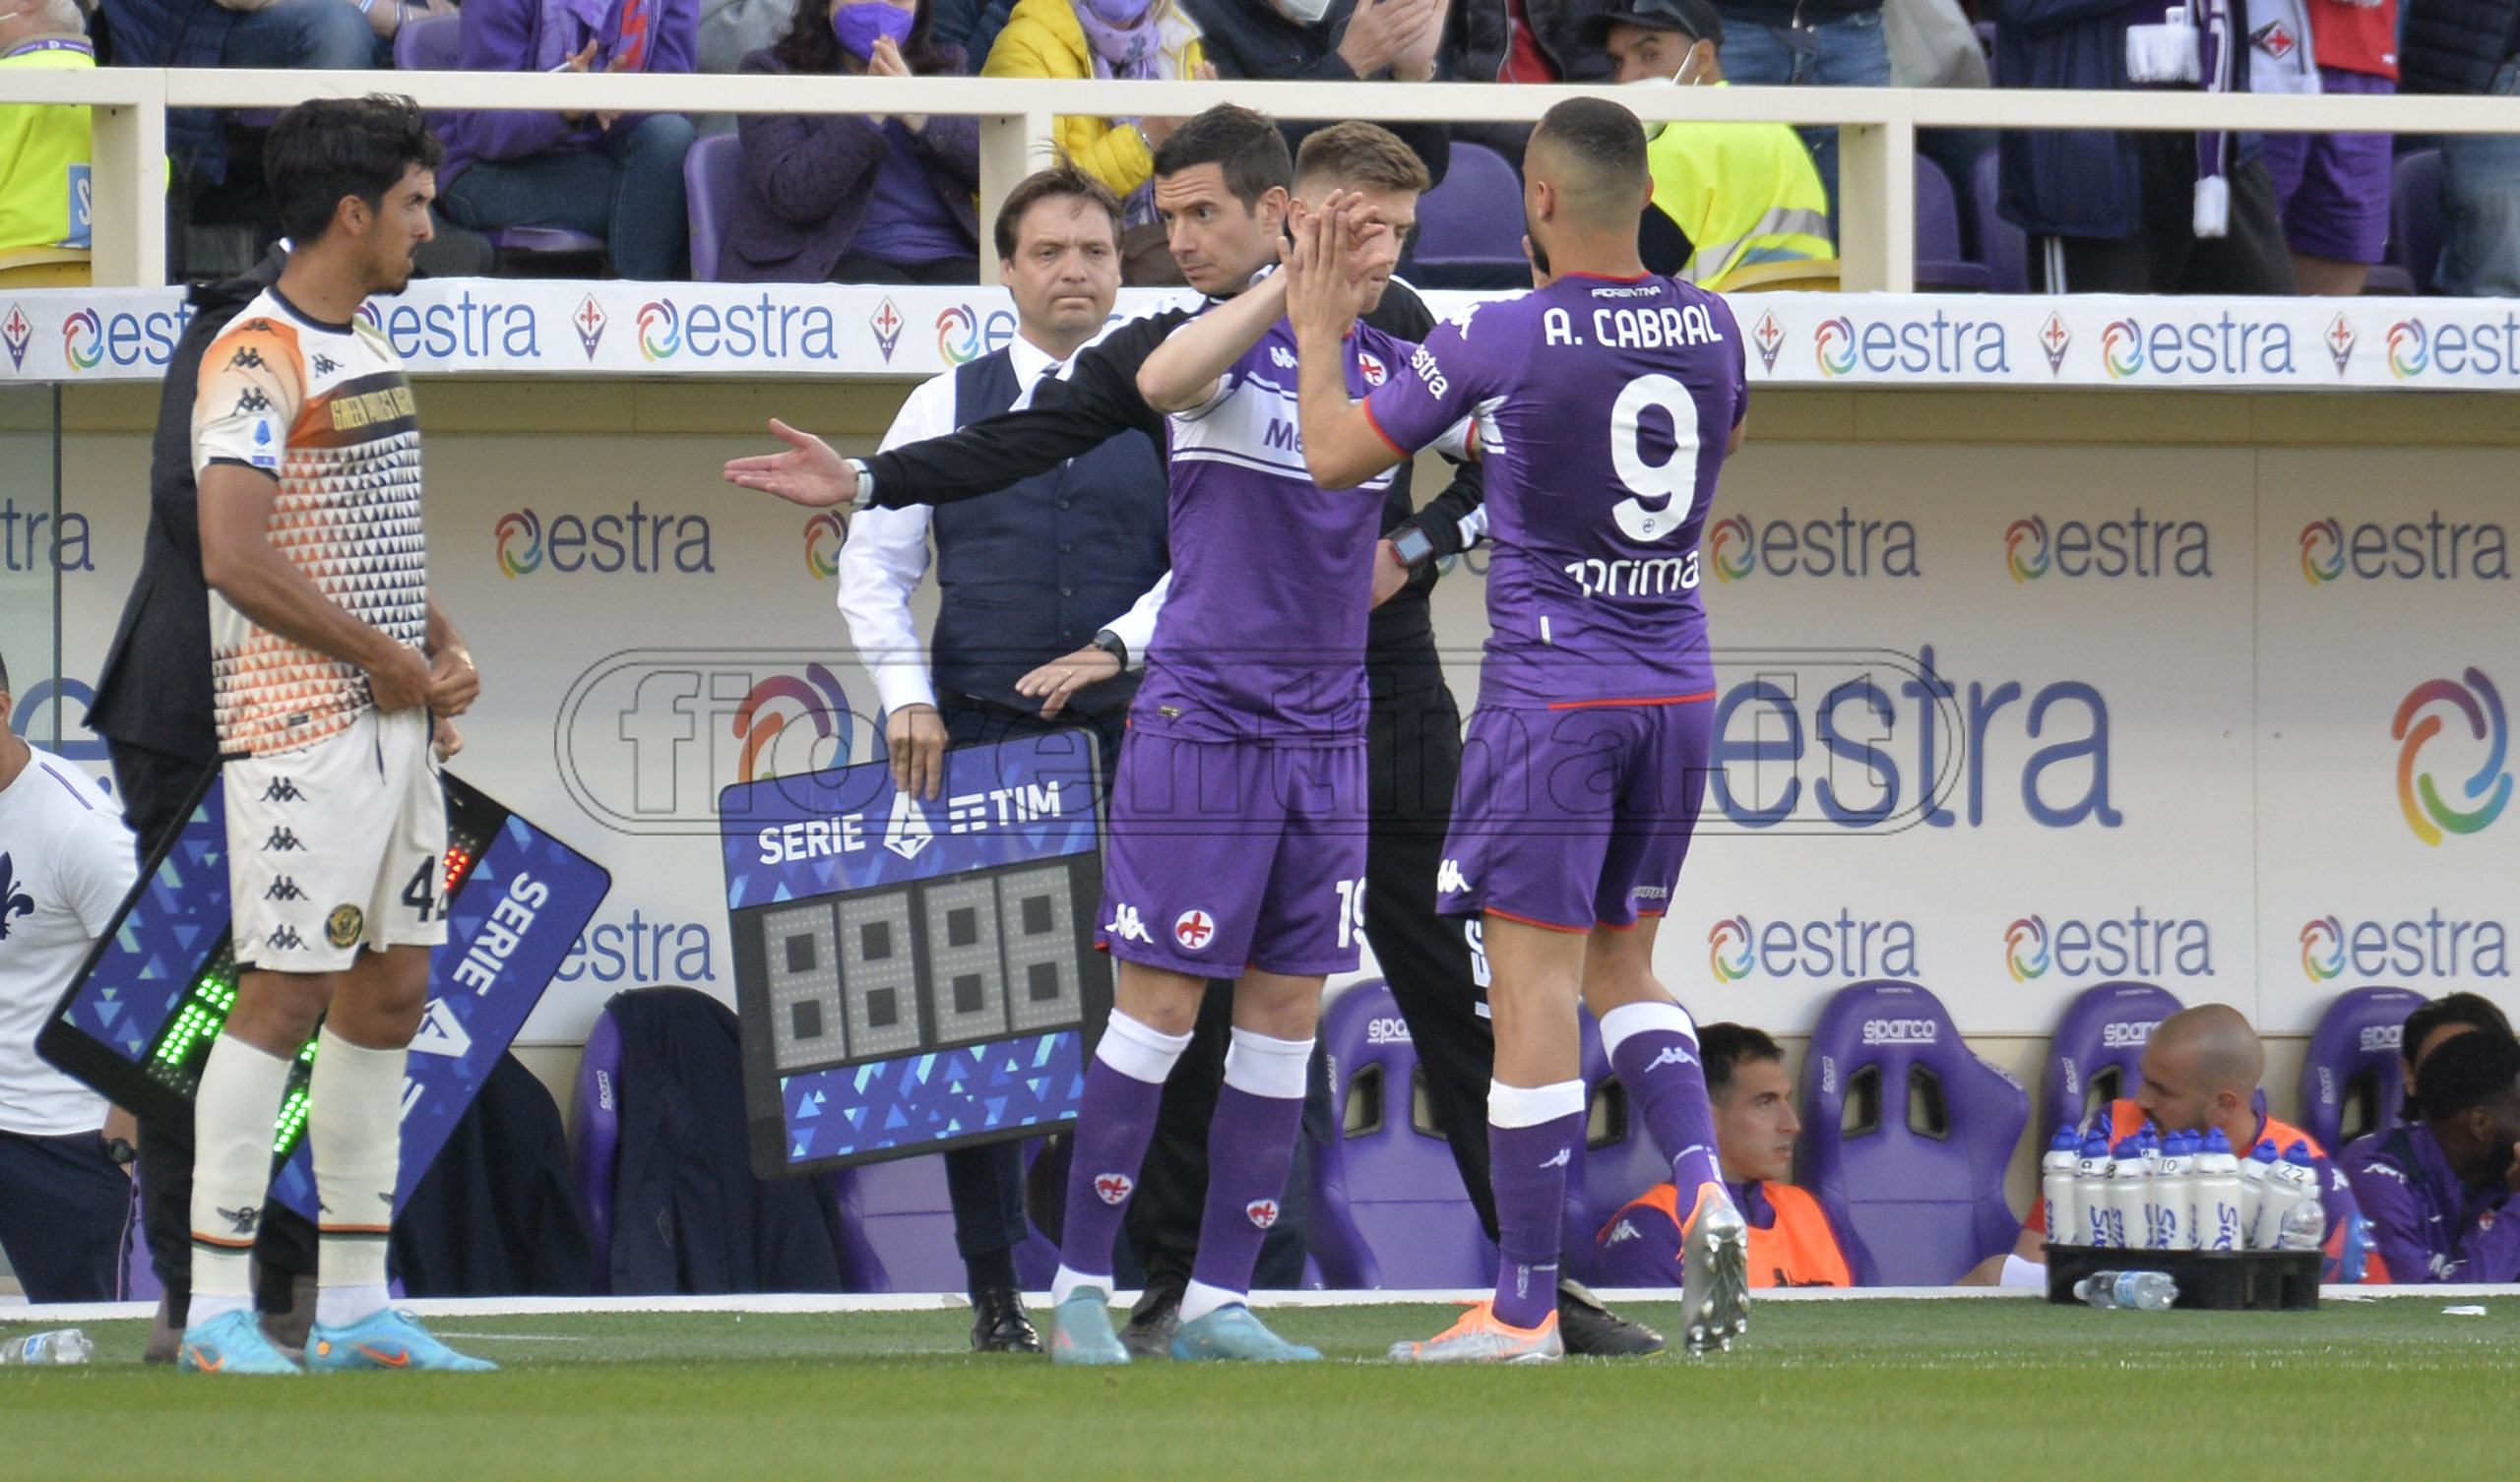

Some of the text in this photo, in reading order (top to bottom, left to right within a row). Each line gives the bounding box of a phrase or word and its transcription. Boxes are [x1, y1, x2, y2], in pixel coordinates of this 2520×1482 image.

[107, 298, 193, 366] est
[388, 290, 541, 359] estra
[685, 292, 839, 359] estra
[1544, 303, 1724, 348] A. CABRAL
[1861, 309, 2010, 374] estra
[2149, 311, 2296, 376] estra
[1411, 343, 1448, 401] stra
[1610, 372, 1701, 542] 9
[547, 500, 715, 574] estra
[1760, 506, 1921, 579] estra
[2054, 507, 2214, 579] estra
[2350, 510, 2512, 581] estra
[1710, 644, 2124, 830] estra
[989, 780, 1062, 828] TIM
[759, 813, 866, 866] SERIE
[452, 871, 549, 997] SERIE
[555, 909, 716, 983] estra
[1760, 907, 1920, 979] estra
[2054, 906, 2215, 978] estra
[2350, 907, 2510, 978] estra
[1367, 1018, 1412, 1044] spa
[1862, 1019, 1936, 1045] sparco
[2103, 1021, 2162, 1048] spar
[2161, 1158, 2177, 1172] 10
[2281, 1163, 2305, 1182] 22
